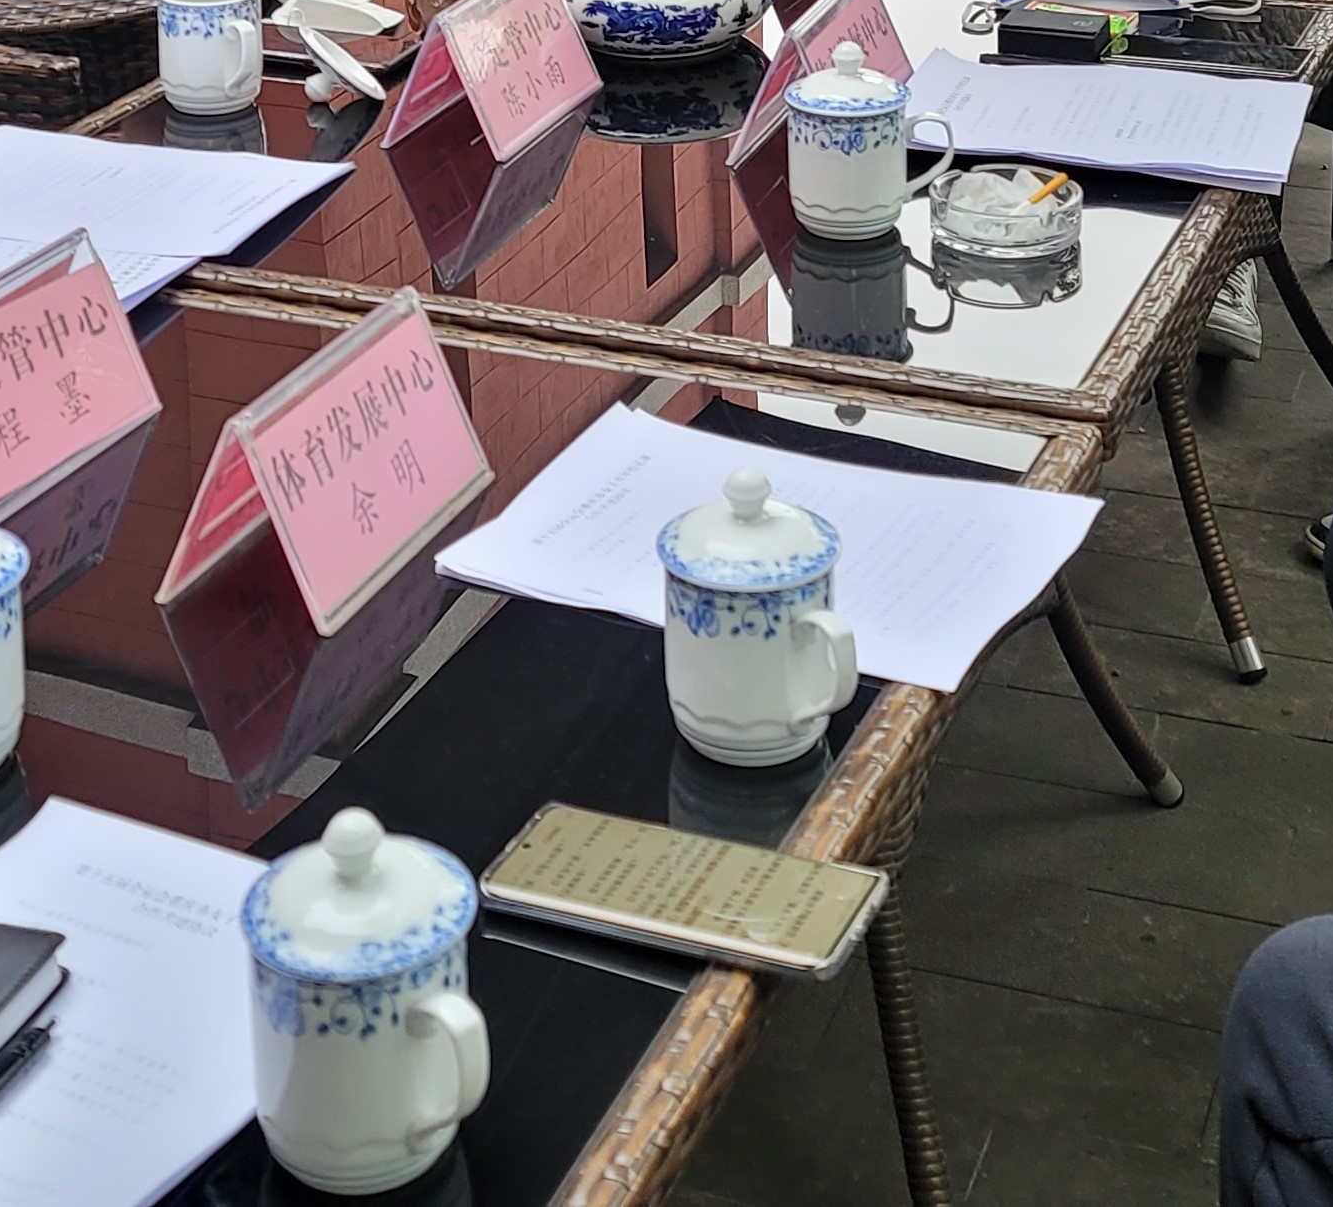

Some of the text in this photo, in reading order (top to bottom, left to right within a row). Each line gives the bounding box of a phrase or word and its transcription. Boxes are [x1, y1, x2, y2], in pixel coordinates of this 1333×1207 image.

[470, 1, 562, 85] 足管中心
[501, 54, 566, 119] 陈小雨
[271, 349, 435, 512] 体育发展中心
